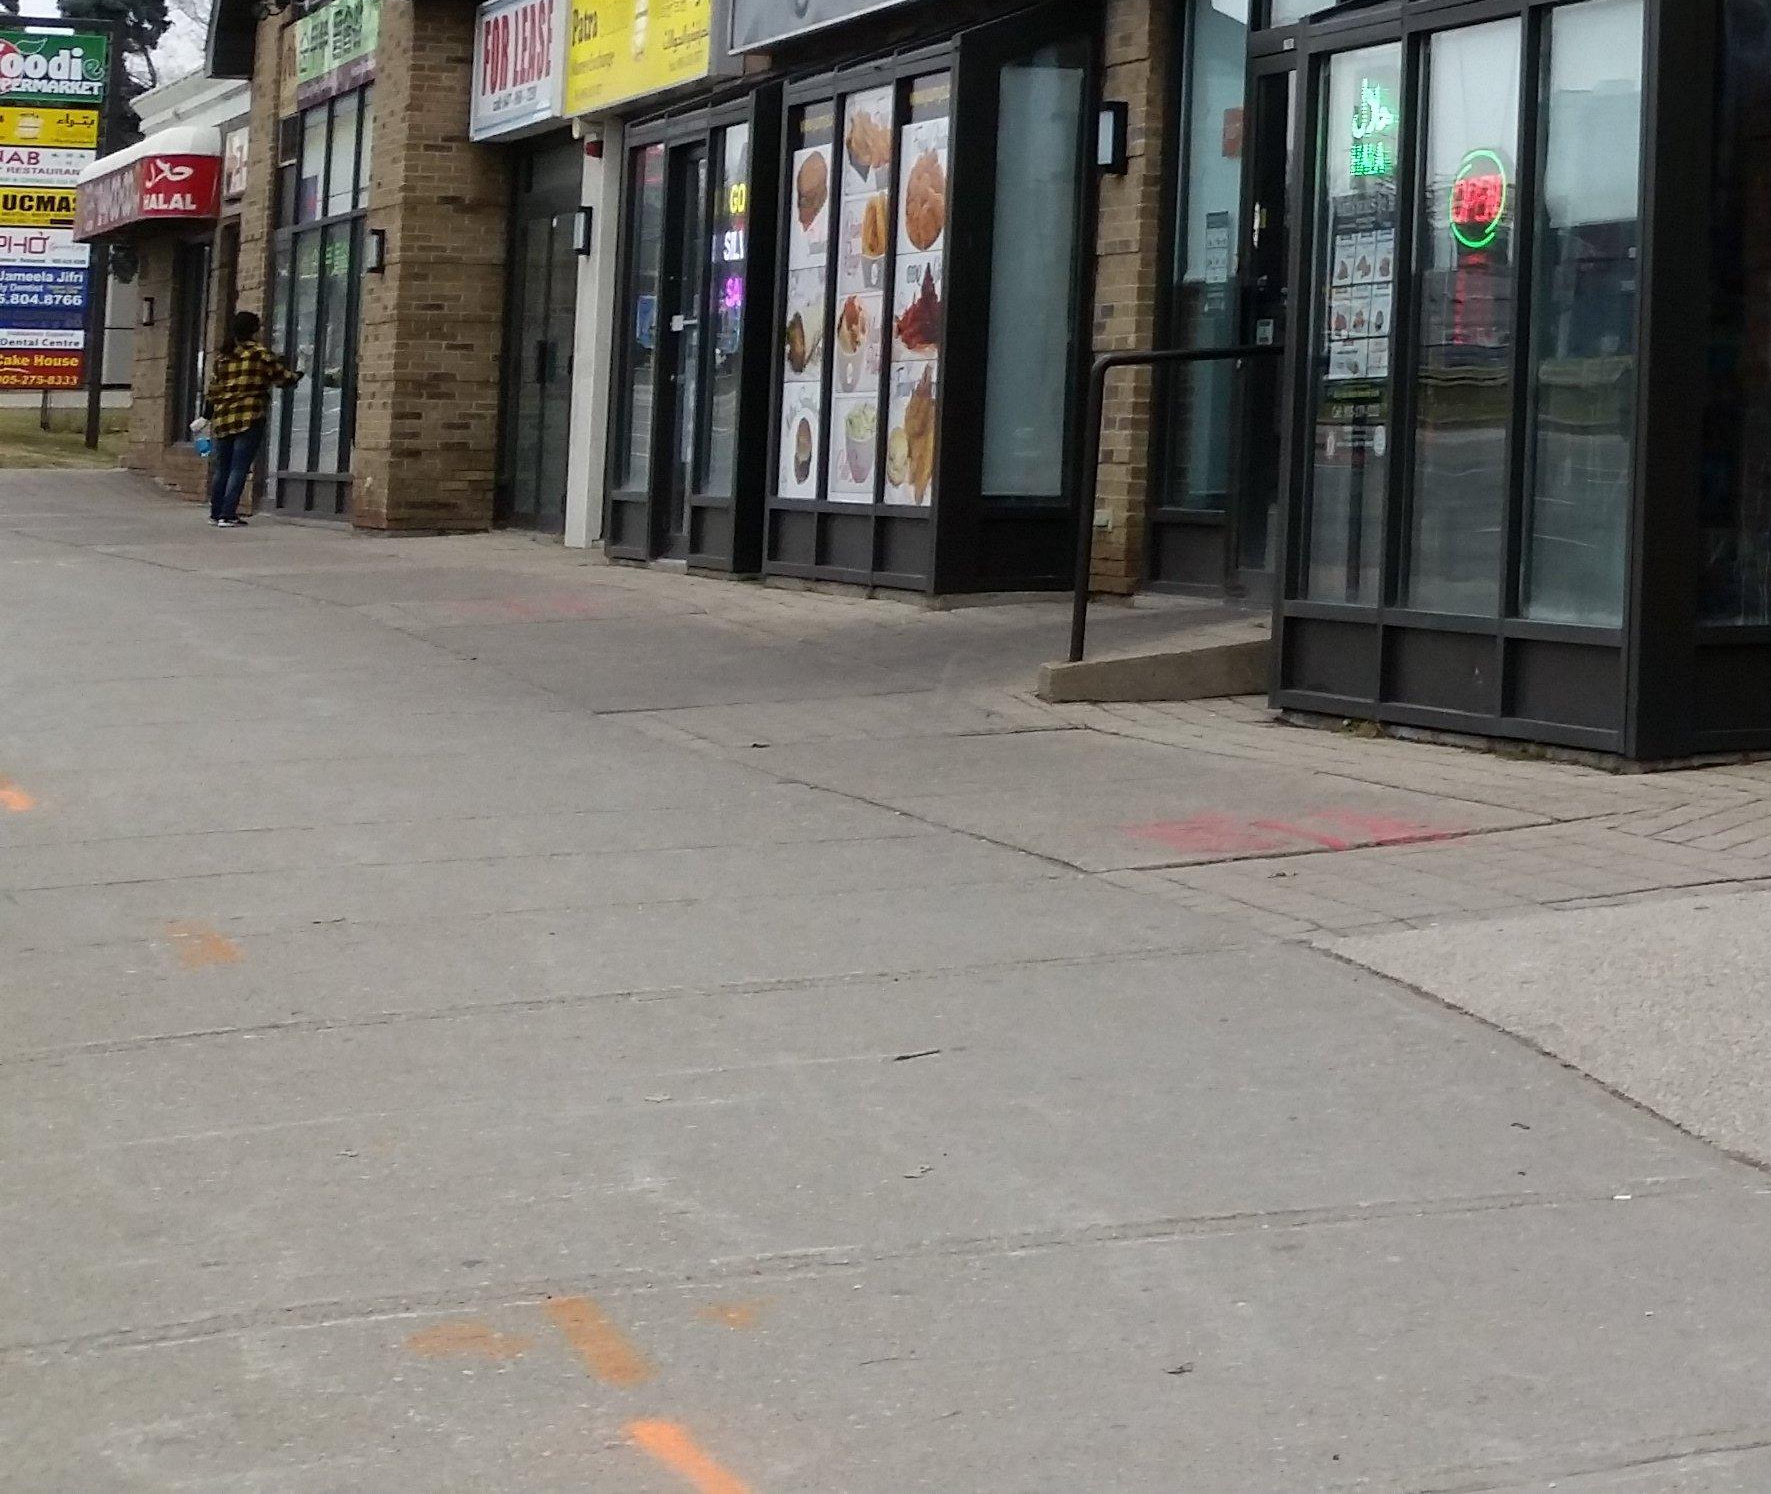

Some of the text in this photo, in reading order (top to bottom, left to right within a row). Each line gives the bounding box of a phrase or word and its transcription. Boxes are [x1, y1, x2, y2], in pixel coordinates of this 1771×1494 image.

[482, 14, 510, 96] FOR
[0, 150, 40, 165] AB
[56, 271, 84, 283] Jifri
[42, 337, 80, 348] Centre
[33, 354, 80, 367] House
